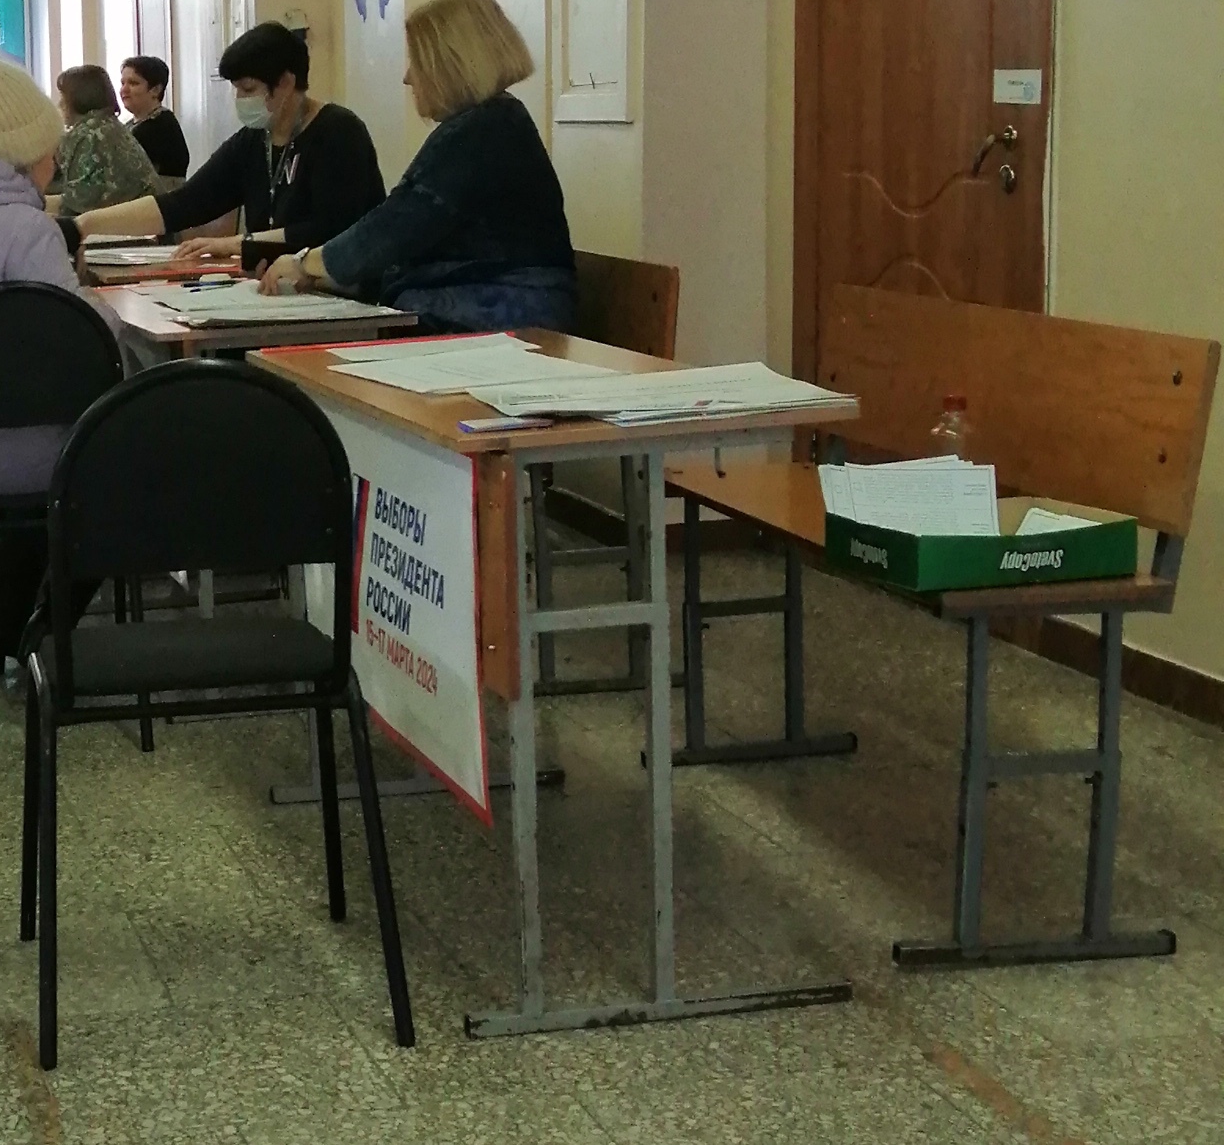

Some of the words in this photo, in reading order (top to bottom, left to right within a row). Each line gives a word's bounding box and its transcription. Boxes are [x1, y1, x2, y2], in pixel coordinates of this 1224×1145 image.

[374, 487, 427, 546] ВЫБОРЫ
[370, 532, 445, 609] ПРЕЗИДЕНТА
[999, 548, 1064, 571] SvetoCopy
[366, 576, 412, 636] РОССИИ
[387, 636, 414, 680] МАРТА
[416, 656, 439, 697] 2024
